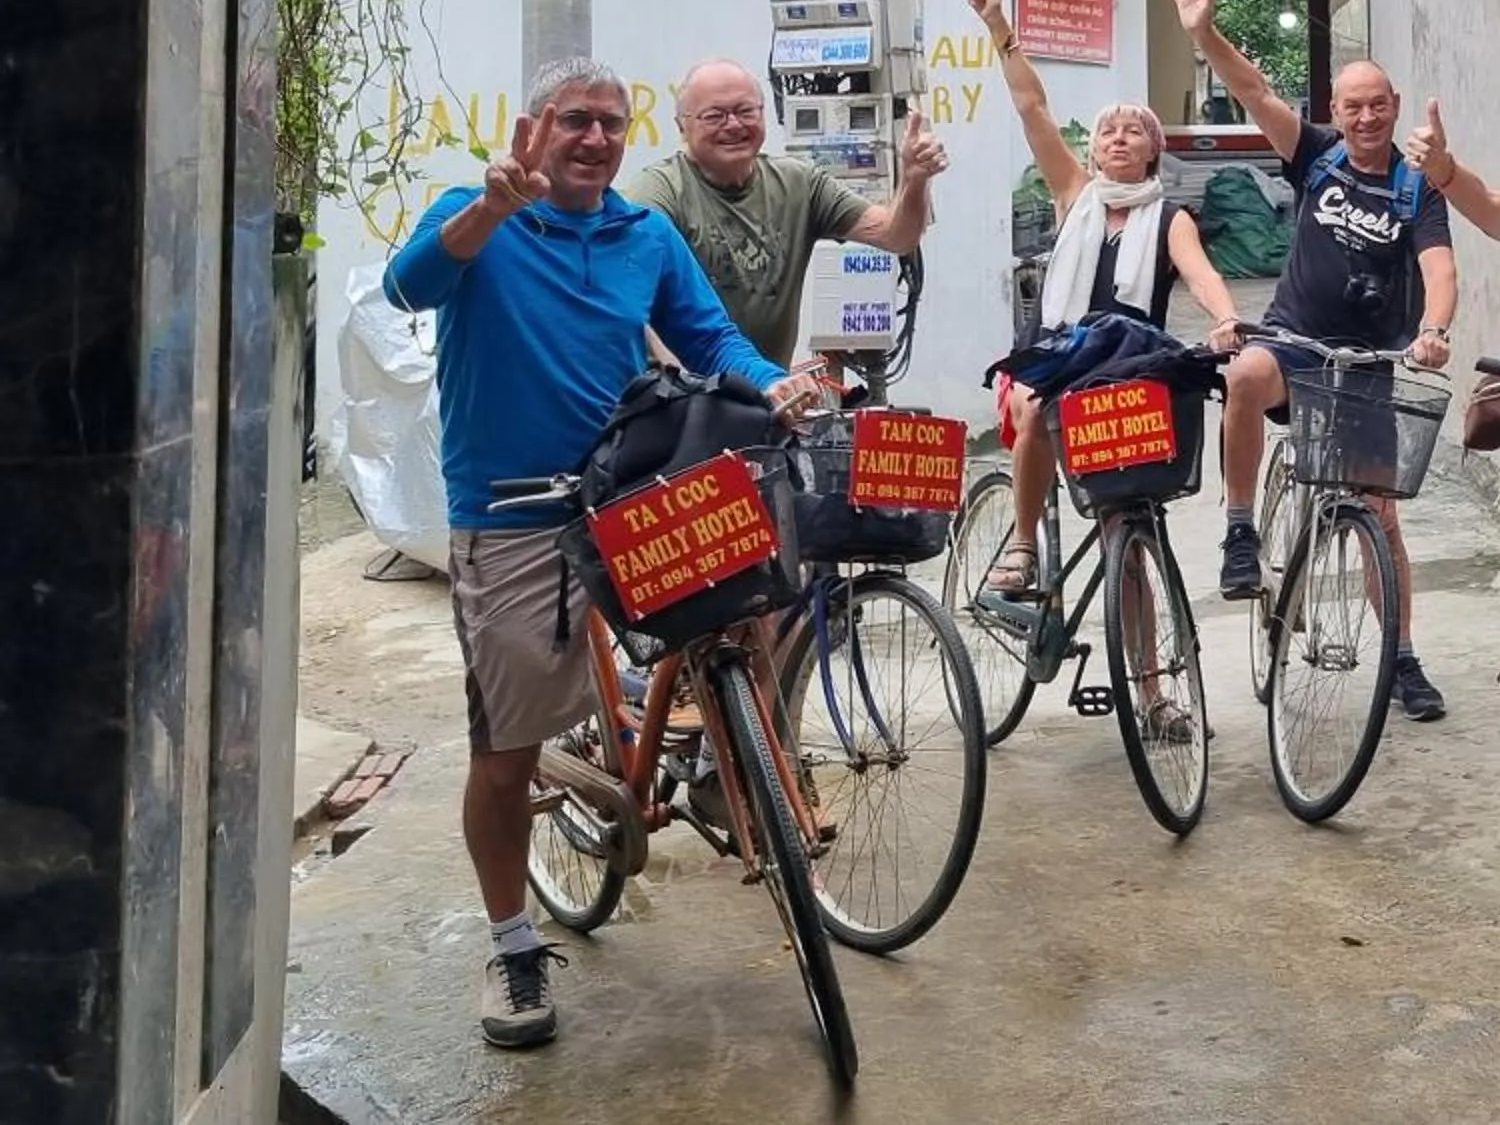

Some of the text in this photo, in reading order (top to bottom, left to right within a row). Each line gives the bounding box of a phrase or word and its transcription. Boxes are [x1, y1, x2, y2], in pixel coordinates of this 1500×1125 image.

[1081, 387, 1147, 415] TAM COC
[880, 420, 945, 446] TAM COC
[1068, 411, 1169, 448] FAMILY HOTEL
[857, 449, 959, 480] FAMILY HOTEL
[676, 475, 720, 510] COC
[612, 497, 760, 582] FAMILY HOTEL
[660, 566, 694, 590] 094
[696, 548, 725, 573] 367
[729, 528, 771, 557] 7874
